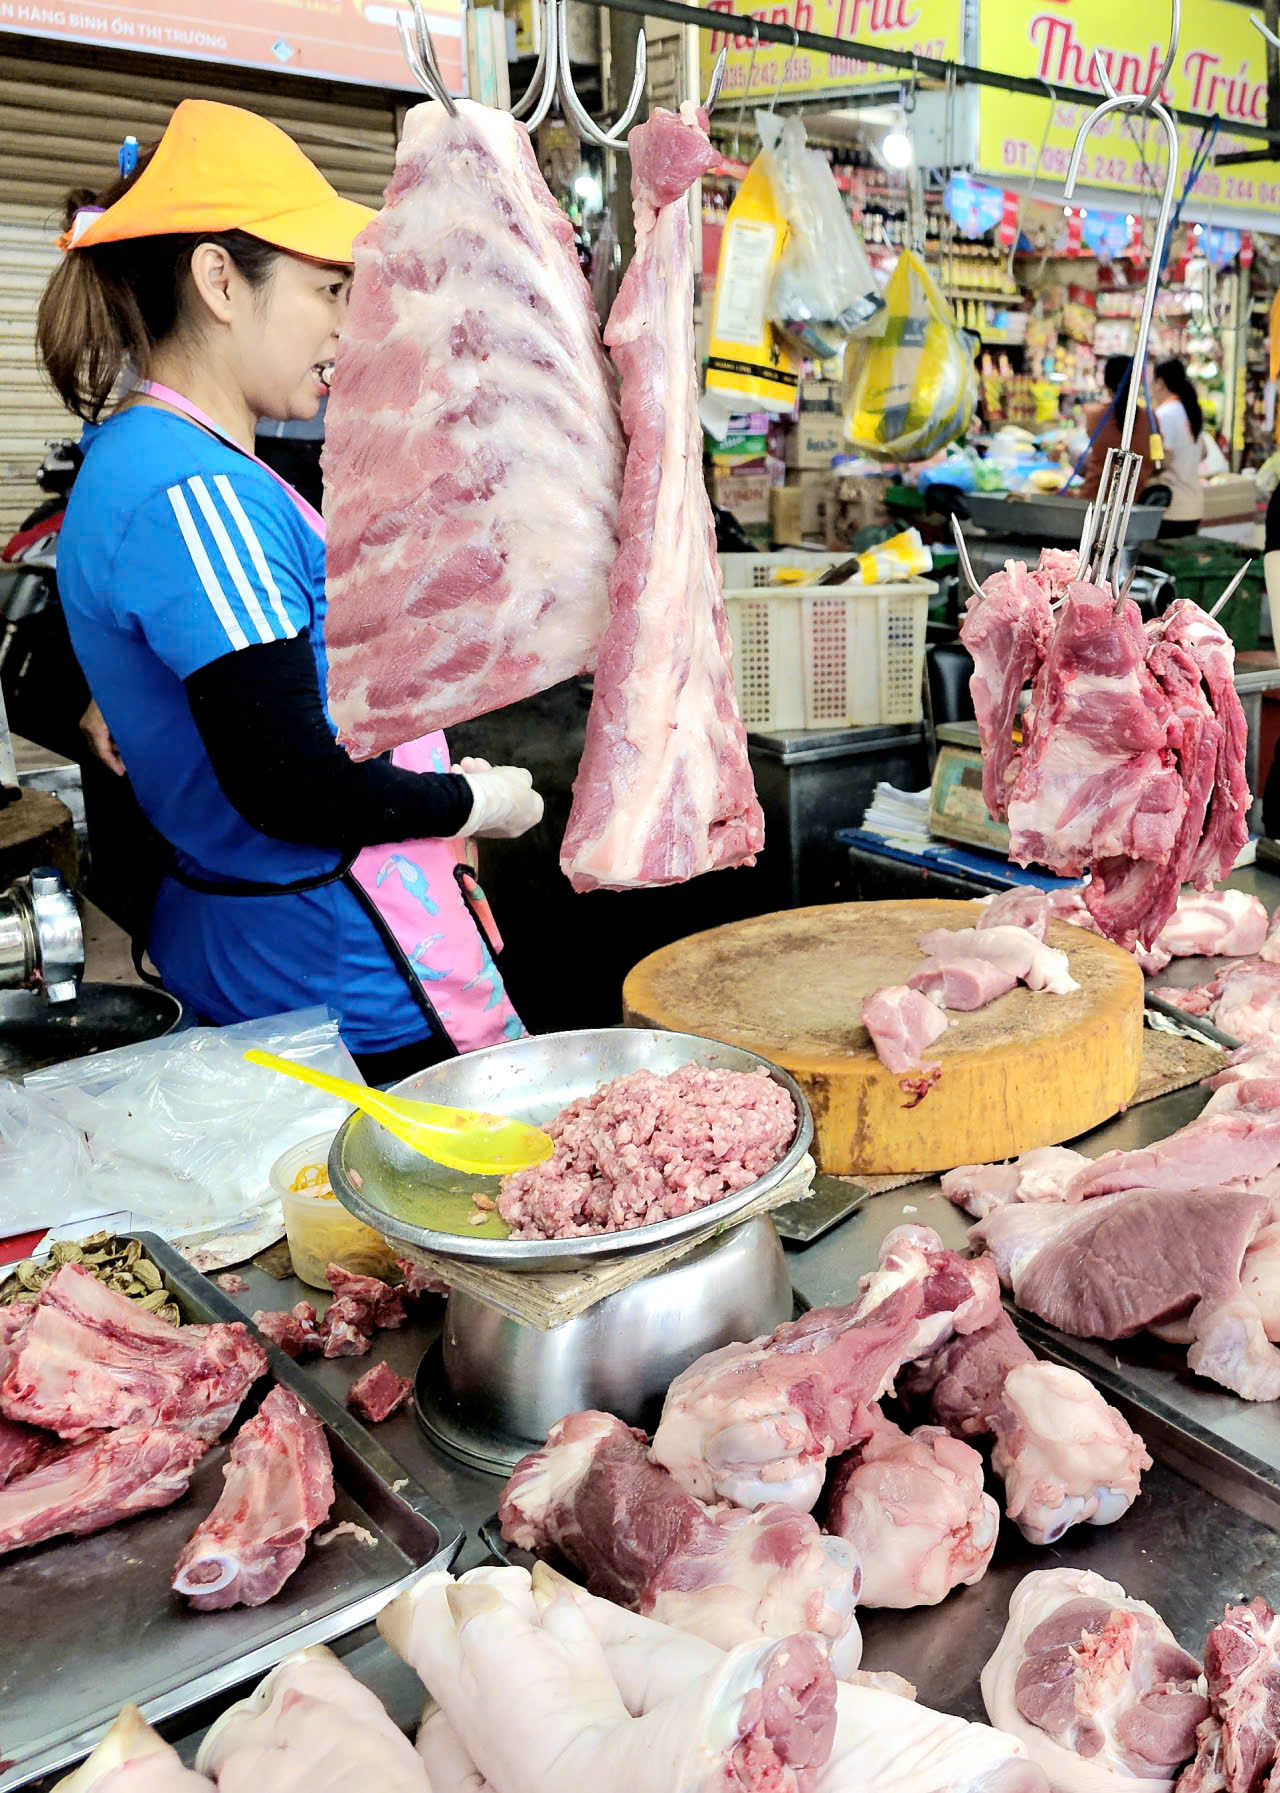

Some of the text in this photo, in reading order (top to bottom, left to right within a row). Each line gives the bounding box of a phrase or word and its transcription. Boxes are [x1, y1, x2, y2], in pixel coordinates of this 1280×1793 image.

[17, 5, 66, 26] HÀNG
[69, 12, 108, 33] BÌNH
[1030, 15, 1173, 104] Thanh
[1184, 51, 1269, 121] Trúc
